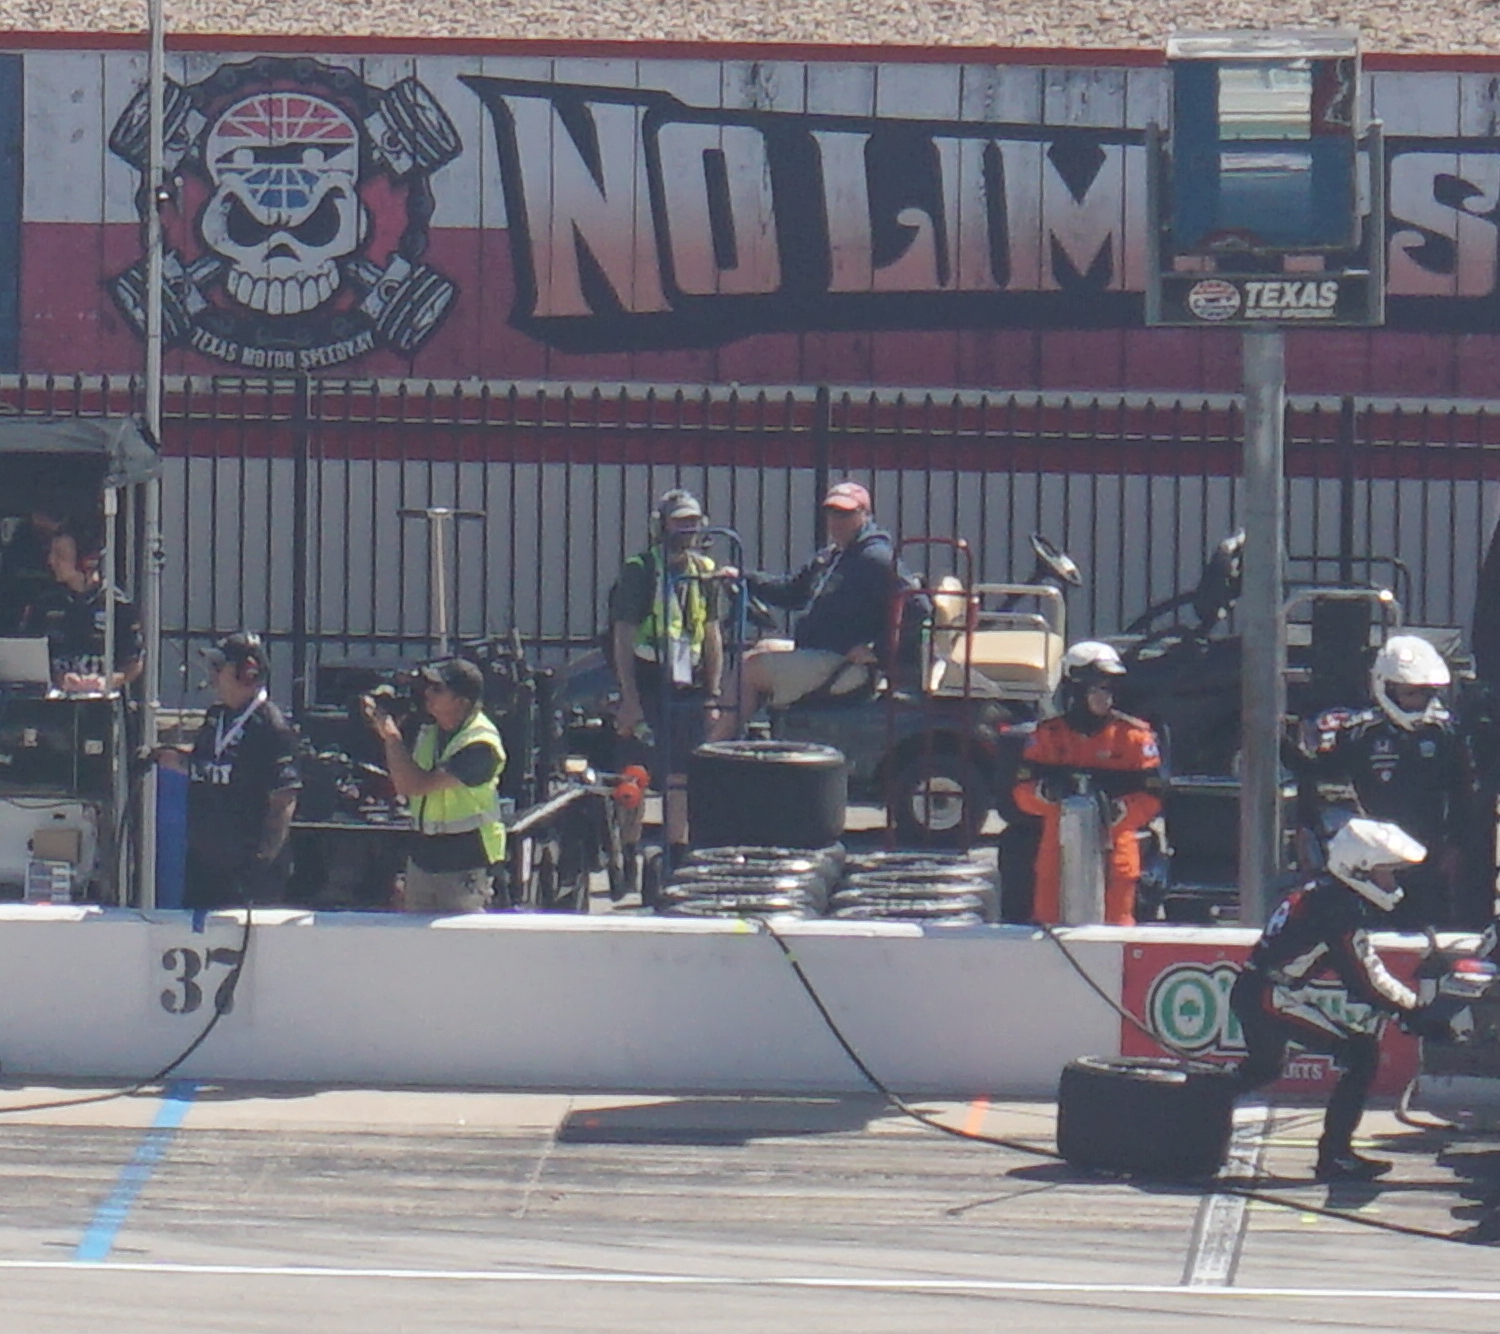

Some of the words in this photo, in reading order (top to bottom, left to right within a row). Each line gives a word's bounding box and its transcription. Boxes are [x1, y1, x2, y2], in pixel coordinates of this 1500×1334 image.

[505, 95, 783, 319] NO
[1244, 280, 1339, 309] TEXAS
[191, 325, 238, 363] TEXAS
[242, 346, 296, 369] MOTOR
[300, 329, 376, 370] SPEEDWAY
[161, 947, 245, 1015] 37
